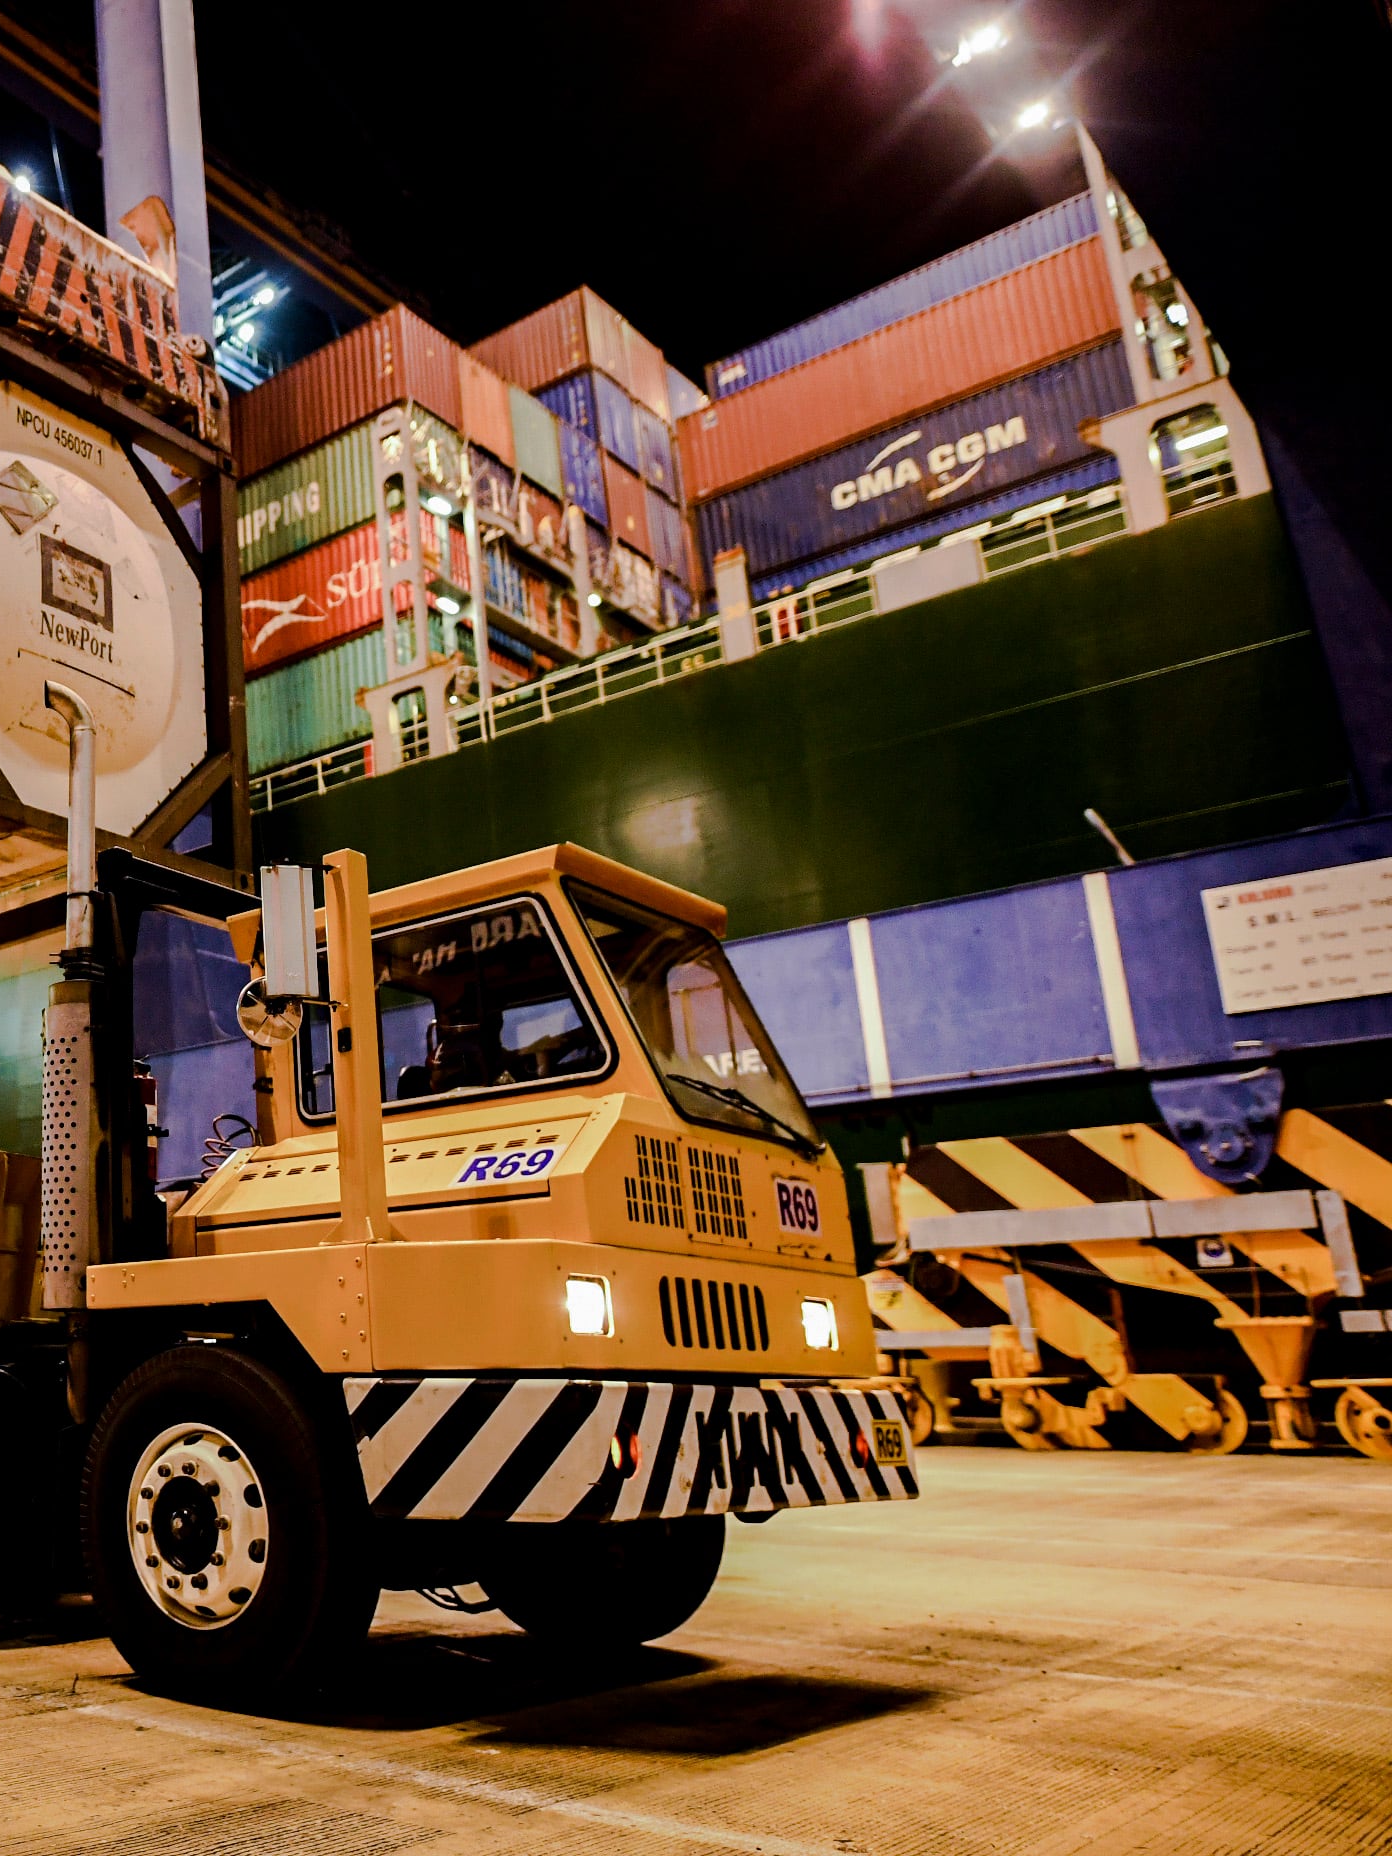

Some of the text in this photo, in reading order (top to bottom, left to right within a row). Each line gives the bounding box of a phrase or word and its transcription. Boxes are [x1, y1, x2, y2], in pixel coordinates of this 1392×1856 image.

[16, 405, 50, 438] NPCU
[54, 427, 93, 460] 456037
[830, 416, 1027, 511] CMA CGM
[39, 610, 113, 663] NewPort
[457, 1149, 554, 1183] R69
[777, 1182, 818, 1232] R69
[876, 1426, 902, 1459] R69
